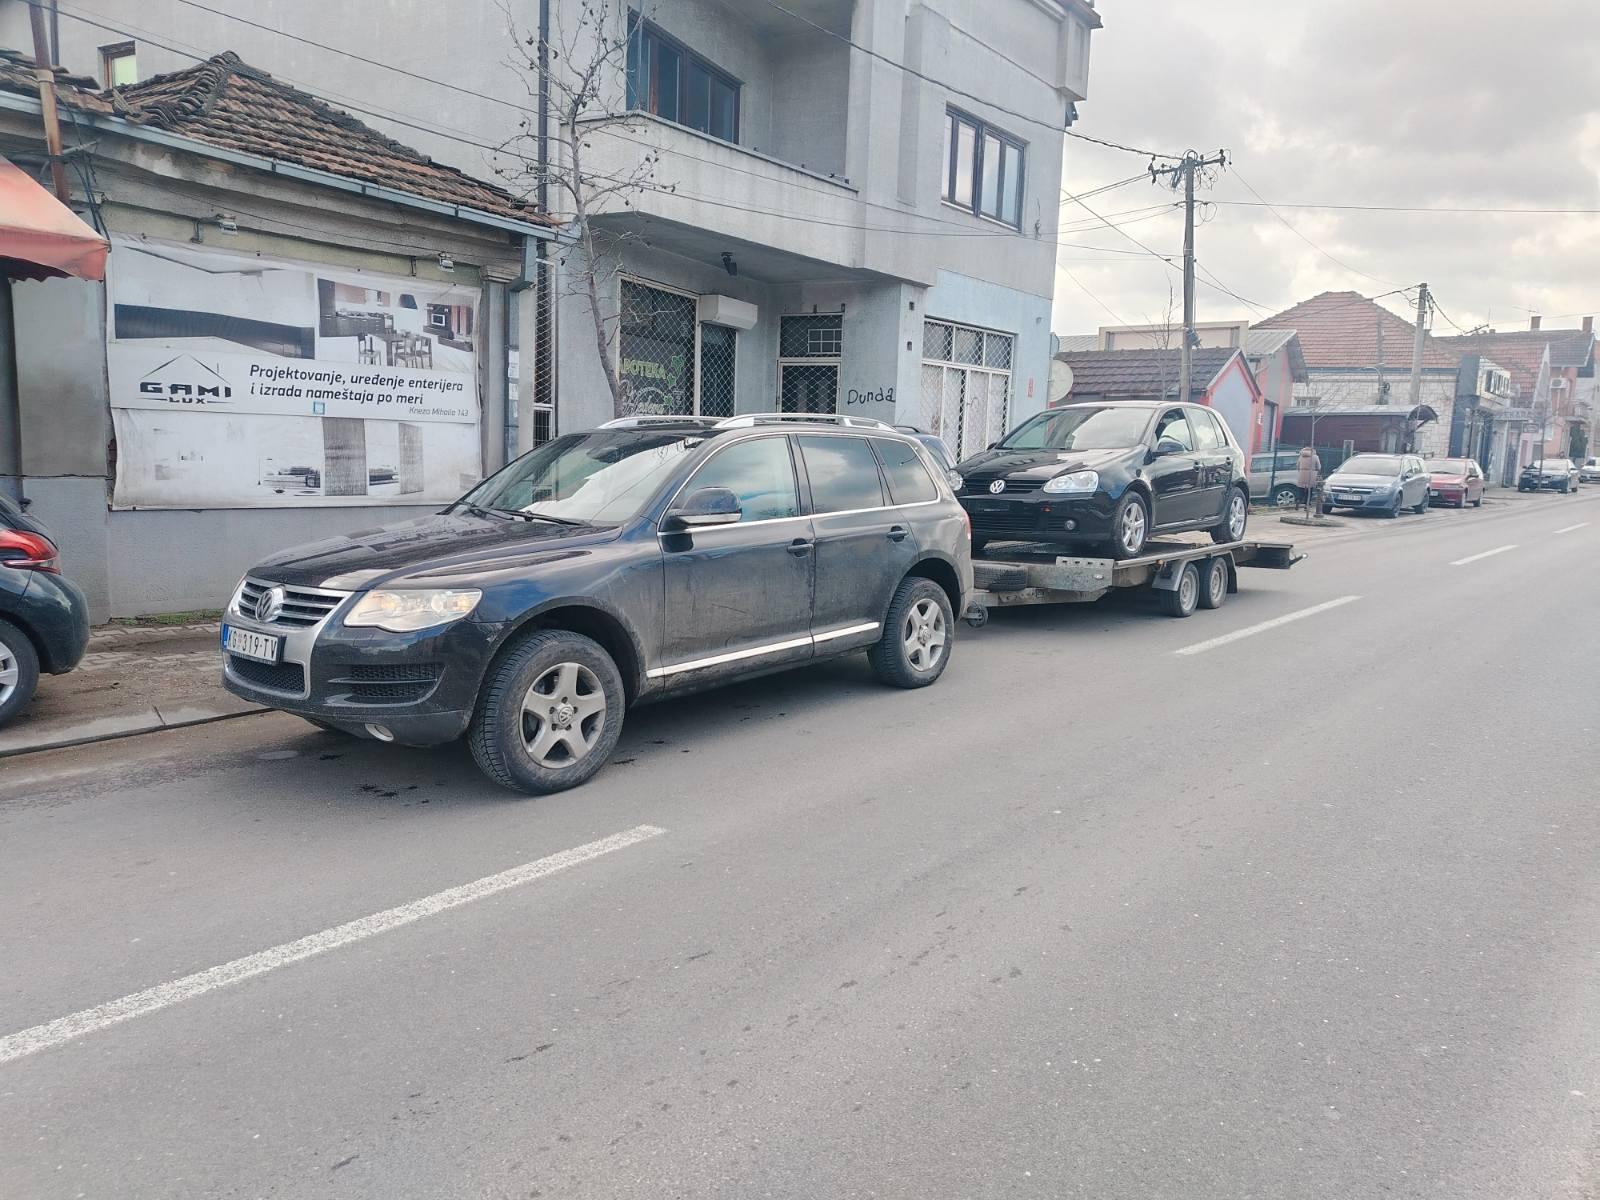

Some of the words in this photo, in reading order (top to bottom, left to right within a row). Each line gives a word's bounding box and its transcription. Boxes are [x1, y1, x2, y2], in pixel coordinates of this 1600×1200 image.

[250, 364, 346, 385] Projektovanje,
[350, 374, 405, 390] uređenje
[408, 378, 464, 393] enterijera
[140, 382, 232, 398] GAMI
[250, 382, 255, 395] i
[259, 383, 302, 398] izrada
[306, 387, 374, 404] nameštaja
[377, 393, 393, 405] po
[396, 393, 424, 405] meri
[847, 386, 896, 405] Dunda
